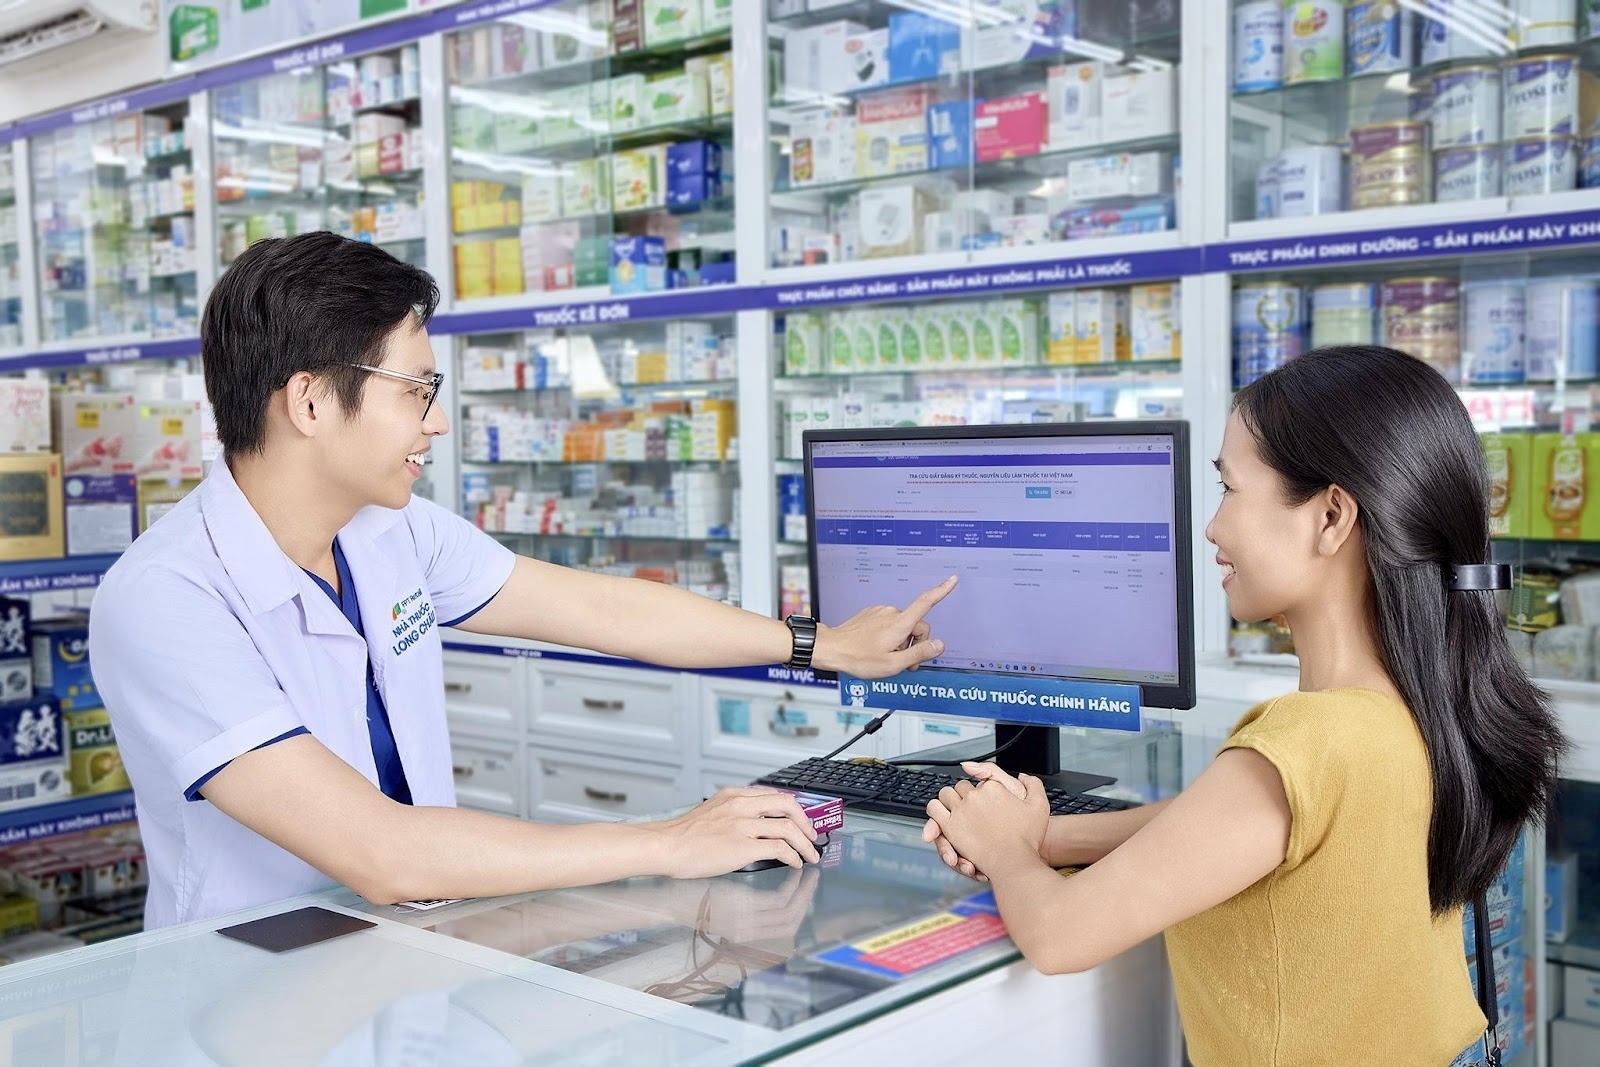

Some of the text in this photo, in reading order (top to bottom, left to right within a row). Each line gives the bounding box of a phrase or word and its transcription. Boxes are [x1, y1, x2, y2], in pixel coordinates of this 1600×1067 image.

[1229, 250, 1268, 267] THỰC
[1271, 243, 1315, 262] PHẨM
[1319, 242, 1357, 258] DINH
[1433, 231, 1468, 249] SẢN
[1472, 225, 1524, 246] PHẨM
[1528, 222, 1566, 241] NÀY
[534, 305, 576, 326] THUỐC
[401, 597, 411, 608] FPT
[392, 602, 430, 638] NHÀ THUỐC
[392, 629, 420, 656] LONG
[768, 667, 791, 680] KHU
[791, 668, 815, 684] VỰC
[872, 681, 1131, 714] KHU VỰC TRA CỨU THUỐC CHÍNH HÃNG
[814, 819, 825, 829] HD
